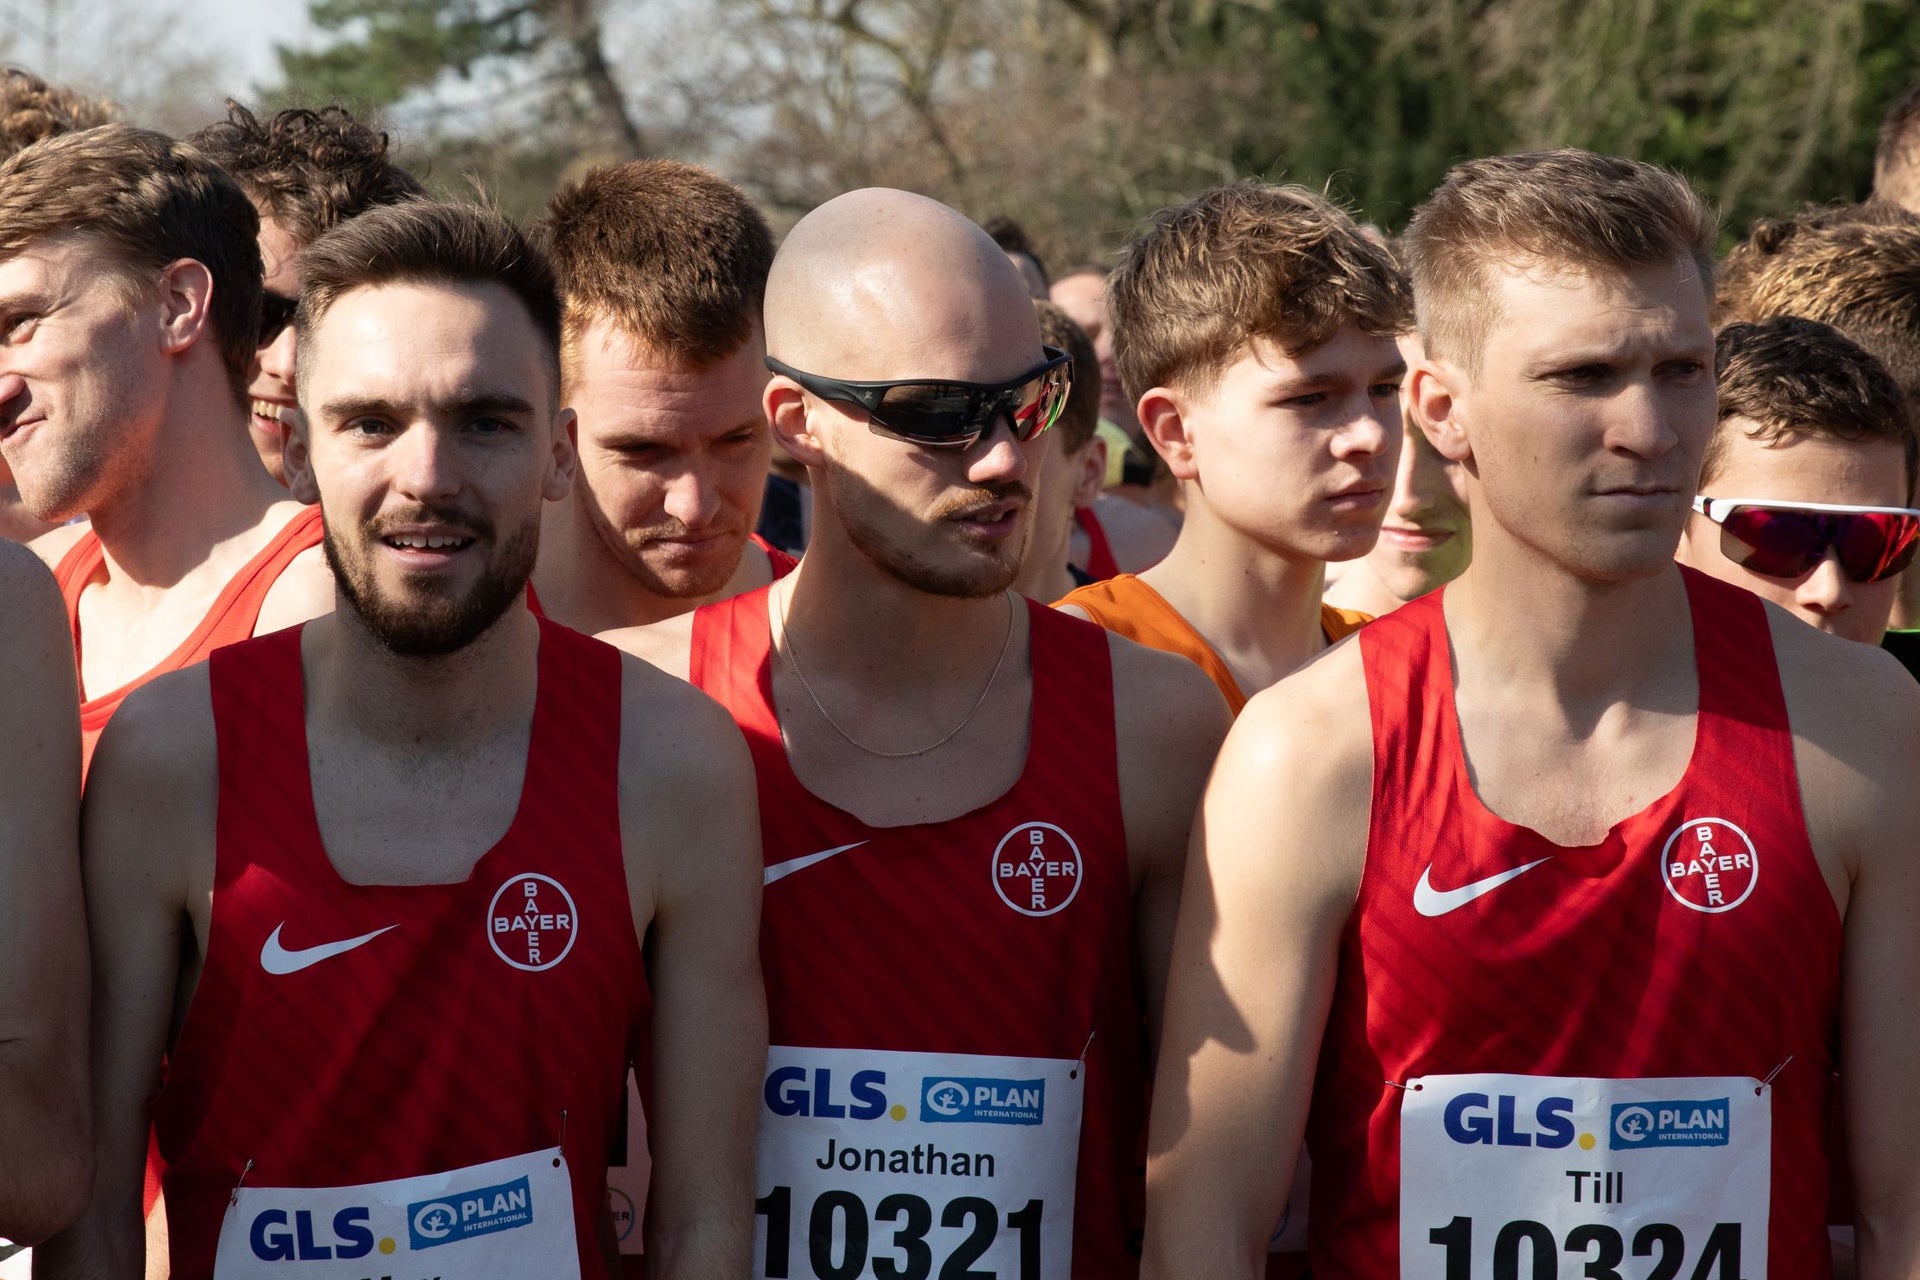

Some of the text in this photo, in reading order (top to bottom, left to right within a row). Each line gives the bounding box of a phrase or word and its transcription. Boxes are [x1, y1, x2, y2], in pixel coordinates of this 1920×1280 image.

[1000, 861, 1075, 878] BAYER
[1029, 830, 1047, 909] BAYER
[1670, 853, 1751, 878] BAYER
[1696, 826, 1725, 906] BAYER
[494, 914, 570, 933] BAYER
[524, 881, 541, 964] BAYER
[974, 1086, 1040, 1109] PLAN
[974, 1109, 1038, 1119] INTERNATIONAL
[1658, 1109, 1724, 1130] PLAN
[1658, 1132, 1724, 1140] INTERNATIONAL
[816, 1138, 995, 1177] Jonathan
[1566, 1170, 1623, 1204] Till
[461, 1188, 527, 1221] PLAN
[463, 1212, 528, 1232] INTERNATIONAL
[755, 1186, 1044, 1280] 10321
[1429, 1216, 1748, 1280] 10324
